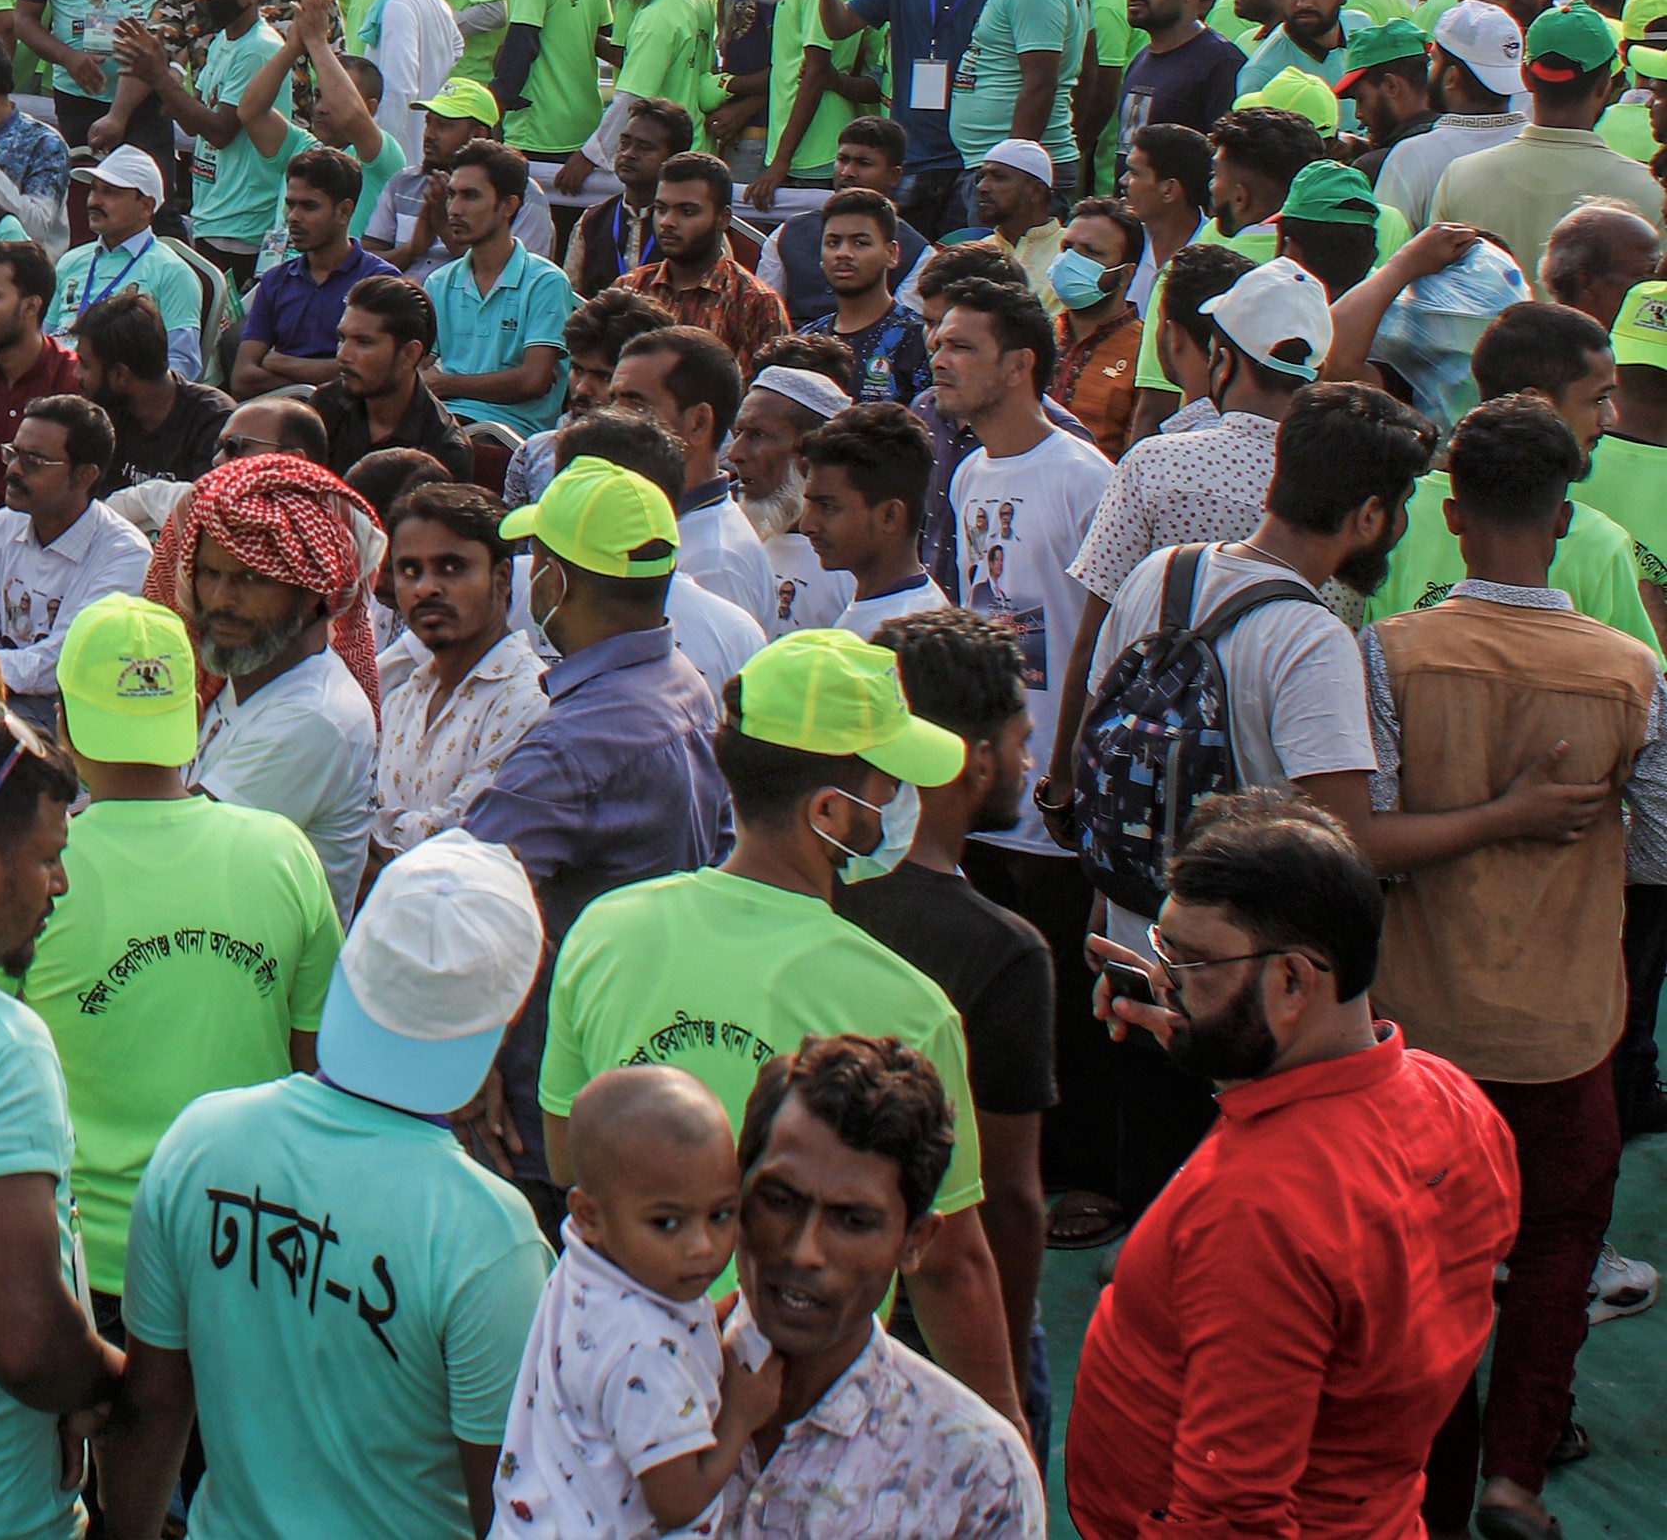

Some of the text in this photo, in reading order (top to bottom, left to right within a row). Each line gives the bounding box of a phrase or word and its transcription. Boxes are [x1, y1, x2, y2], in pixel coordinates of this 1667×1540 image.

[108, 933, 170, 985] কেরাণীগঞ্জ
[174, 927, 205, 950] থানা
[210, 929, 264, 964] আওয়ামী
[256, 958, 278, 998] লীগ
[650, 1010, 714, 1060] কেরাণীগঞ্জ
[720, 1022, 751, 1057] থানা
[206, 1185, 398, 1362] ঢাকা-২
